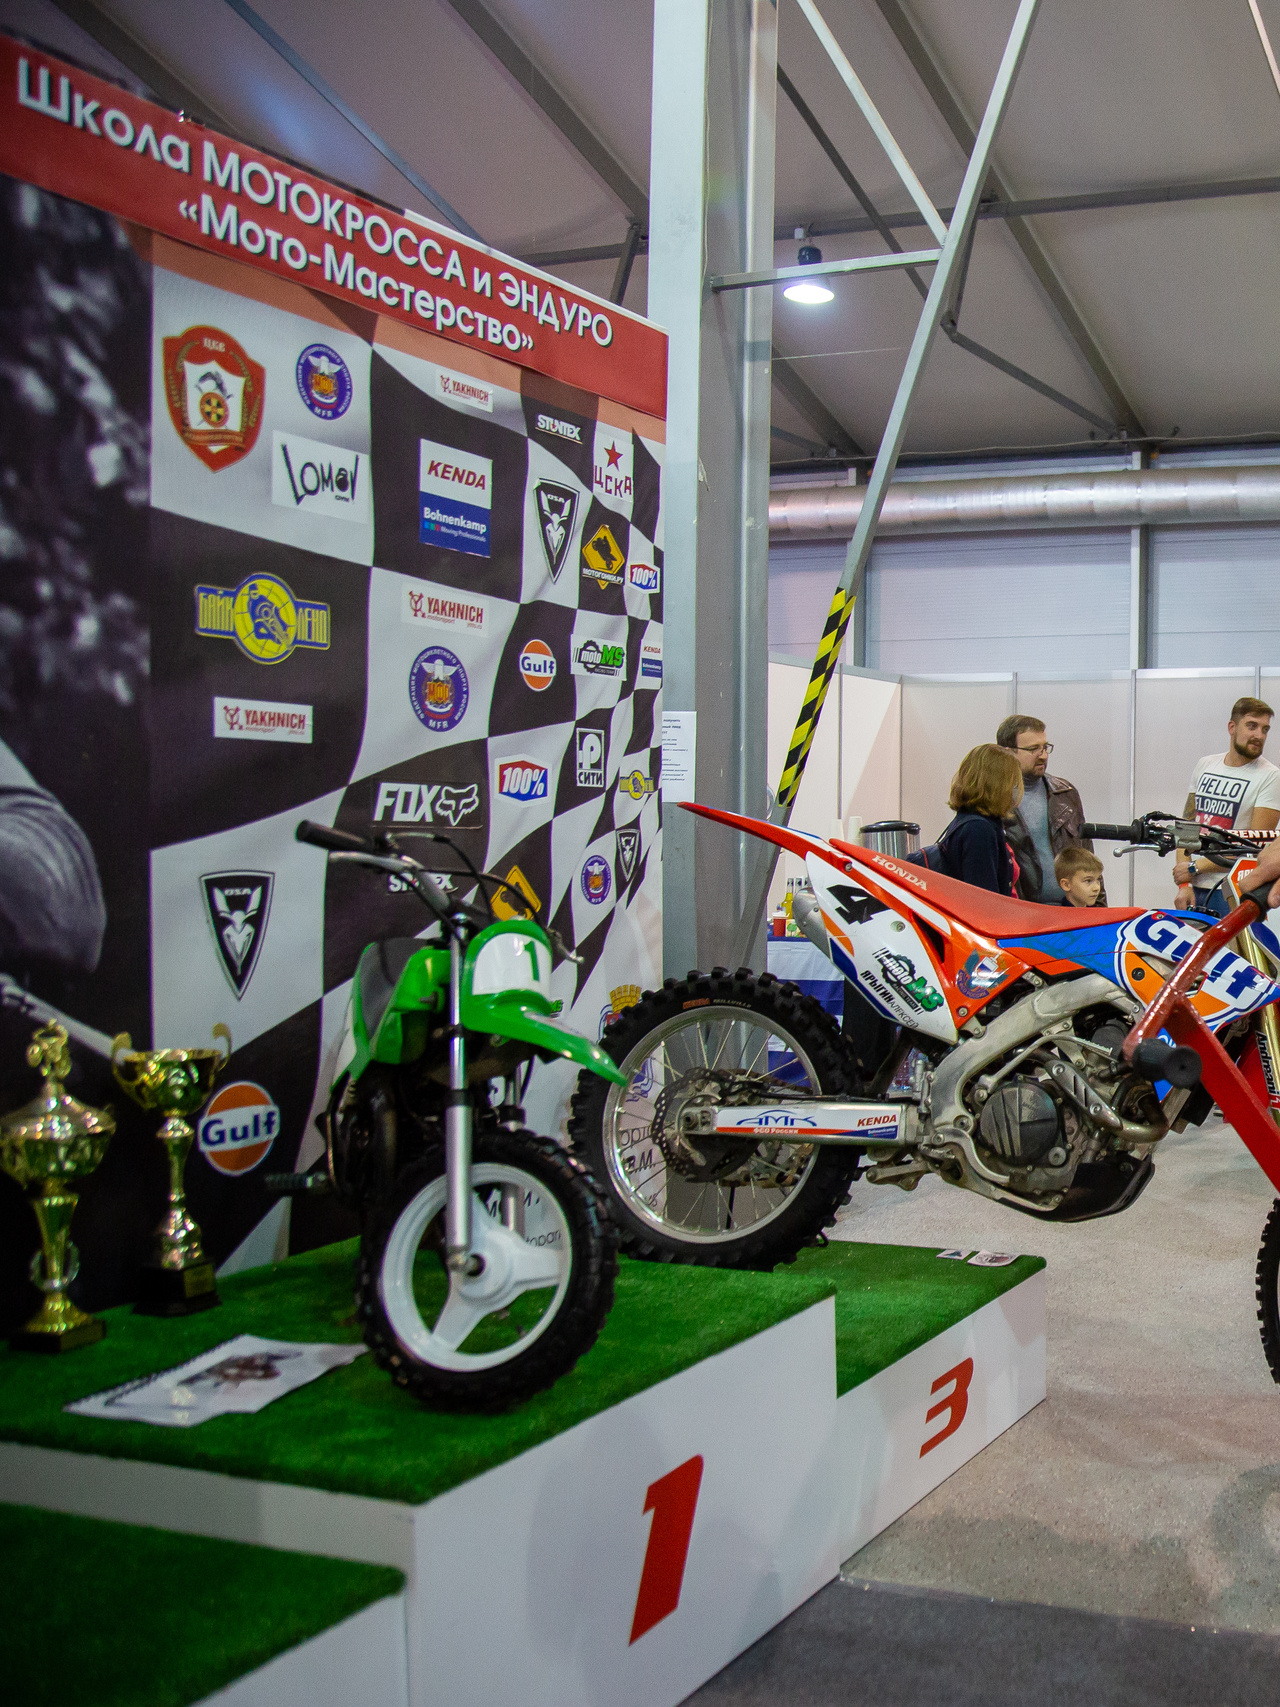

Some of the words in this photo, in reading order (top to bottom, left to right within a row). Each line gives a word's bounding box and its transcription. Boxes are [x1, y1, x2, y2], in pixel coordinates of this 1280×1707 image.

[17, 57, 191, 175] Школа
[203, 141, 467, 290] МОТОКРОССА
[473, 264, 492, 298] и
[498, 273, 613, 348] ЭНДУРО
[179, 194, 535, 354] «Мото-Мастерство»
[452, 380, 489, 402] YAKHNICH
[427, 460, 486, 490] KENDA
[594, 465, 633, 498] ЦСКА
[423, 507, 487, 534] Bohnenkamp
[632, 567, 657, 588] 100%
[427, 597, 484, 623] YAKHNICH
[521, 655, 555, 675] Gulf
[245, 710, 306, 730] YAKHNICH
[429, 719, 449, 730] MFR
[502, 767, 545, 796] 100%
[578, 771, 603, 785] СИТИ
[1198, 776, 1241, 798] HELLO
[373, 782, 441, 823] FOX
[1195, 796, 1234, 817] FLORIDA
[871, 855, 928, 892] HONDA
[827, 884, 893, 925] 4
[524, 940, 540, 982] 1
[860, 970, 895, 1003] ЯРЫГИН
[889, 997, 920, 1029] АЛЕКСЕЙ
[1255, 1031, 1280, 1096] Andreani
[201, 1109, 279, 1147] Gulf
[856, 1114, 897, 1128] KENDA
[919, 1357, 974, 1459] 3
[629, 1454, 704, 1647] 1
